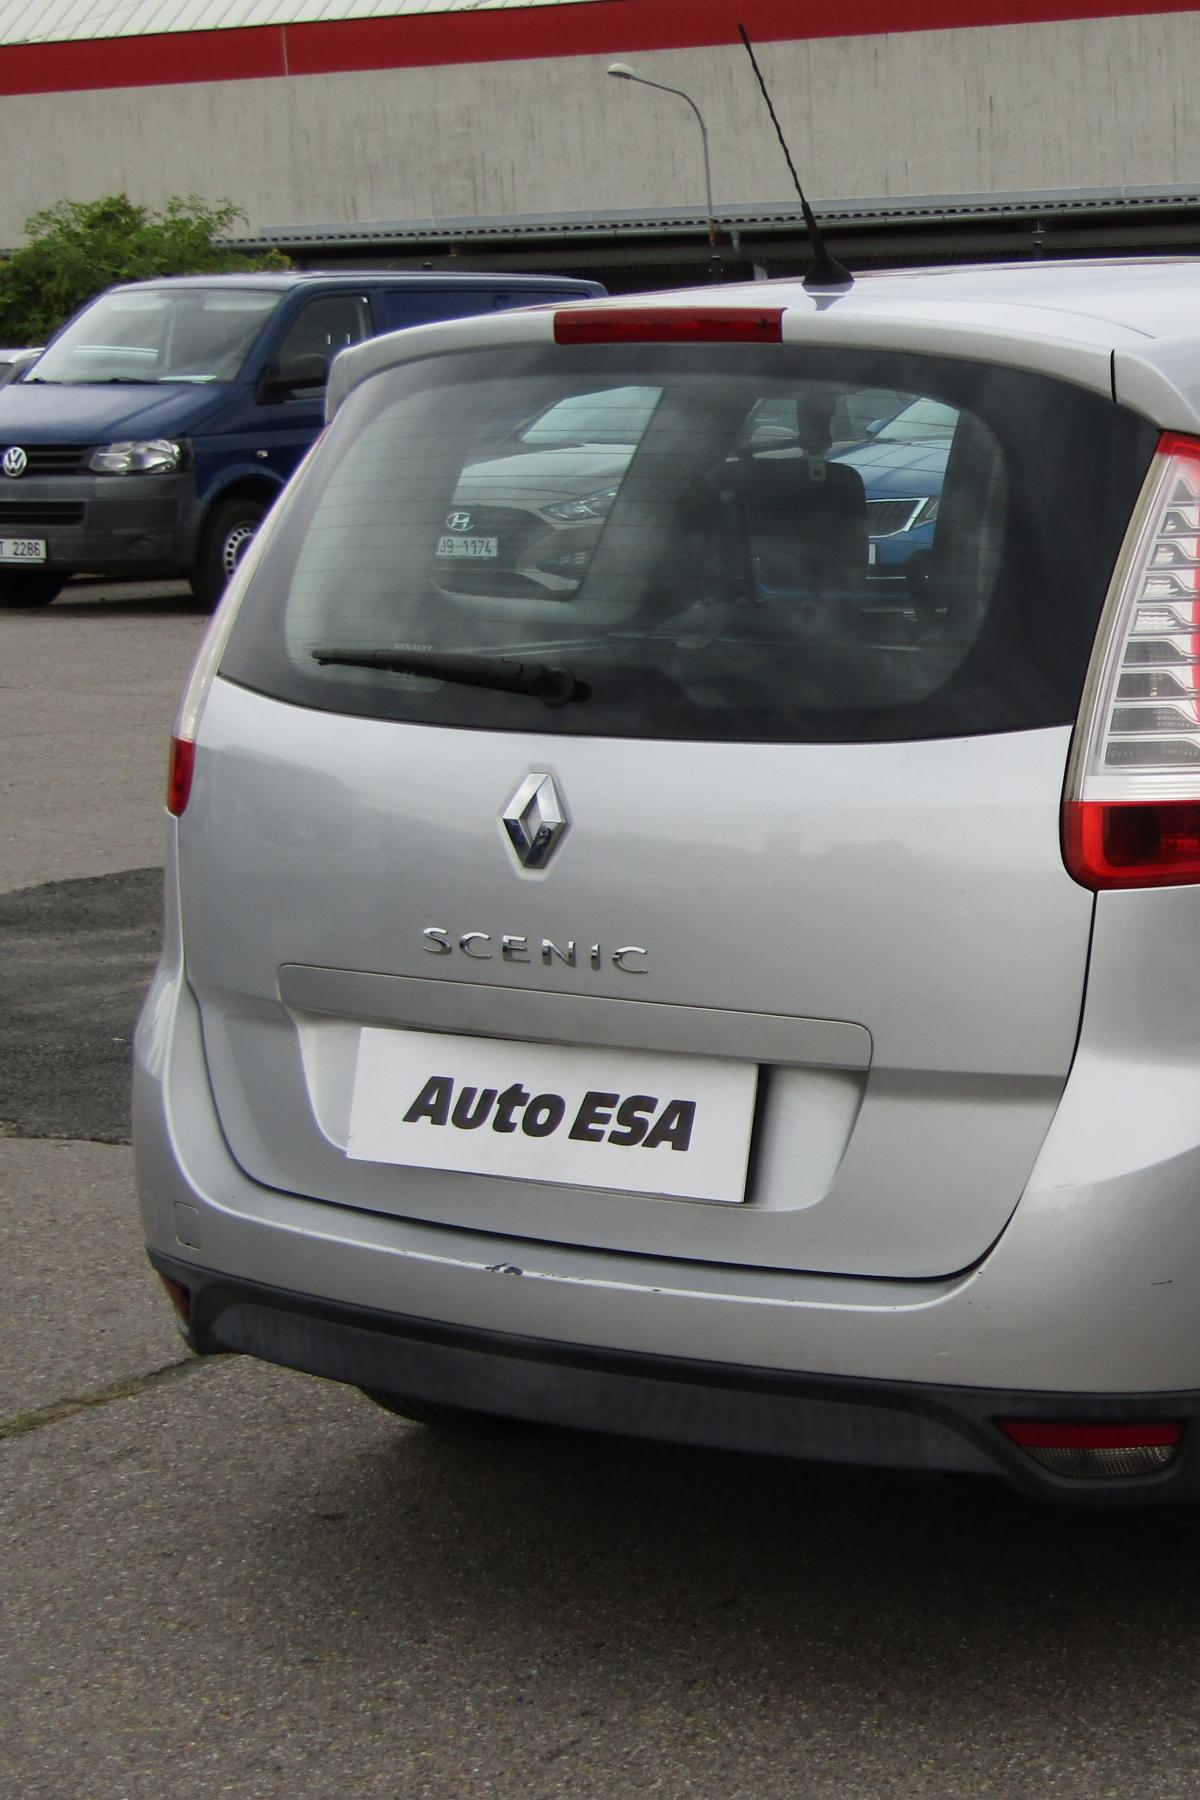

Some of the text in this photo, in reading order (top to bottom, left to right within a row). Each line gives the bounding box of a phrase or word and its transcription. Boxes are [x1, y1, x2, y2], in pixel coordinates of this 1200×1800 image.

[13, 541, 41, 557] 2286
[463, 539, 492, 555] 1174
[422, 927, 648, 974] SCENIC
[402, 1076, 697, 1152] Auto ESA
